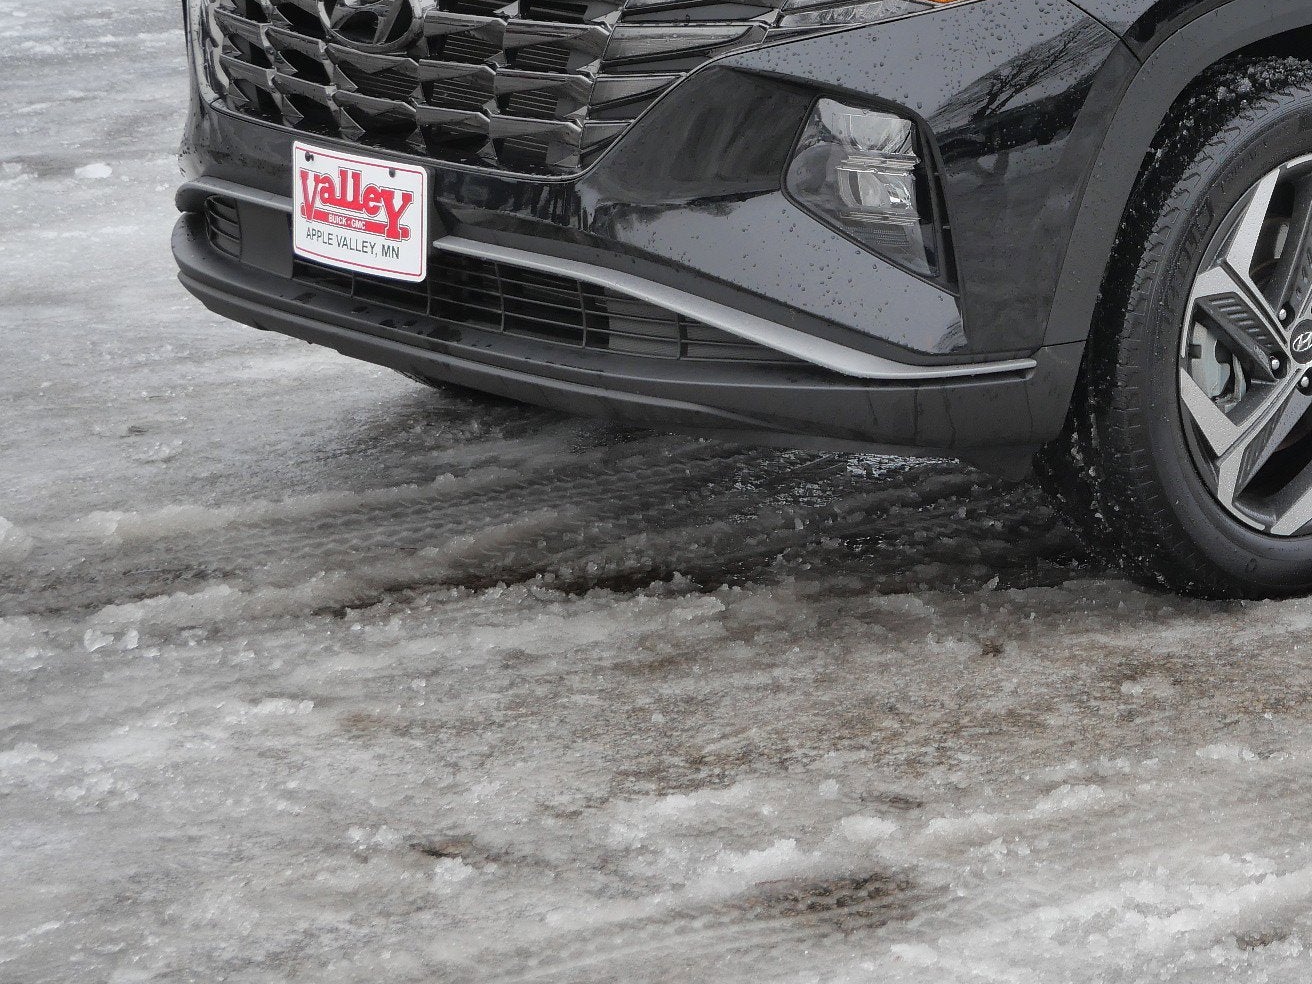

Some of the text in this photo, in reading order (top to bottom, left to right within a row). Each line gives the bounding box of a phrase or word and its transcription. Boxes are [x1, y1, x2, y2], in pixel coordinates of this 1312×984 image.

[300, 167, 414, 241] Valley
[328, 213, 366, 229] BUICK GMC
[306, 227, 400, 259] APPLE VALLEY, MN
